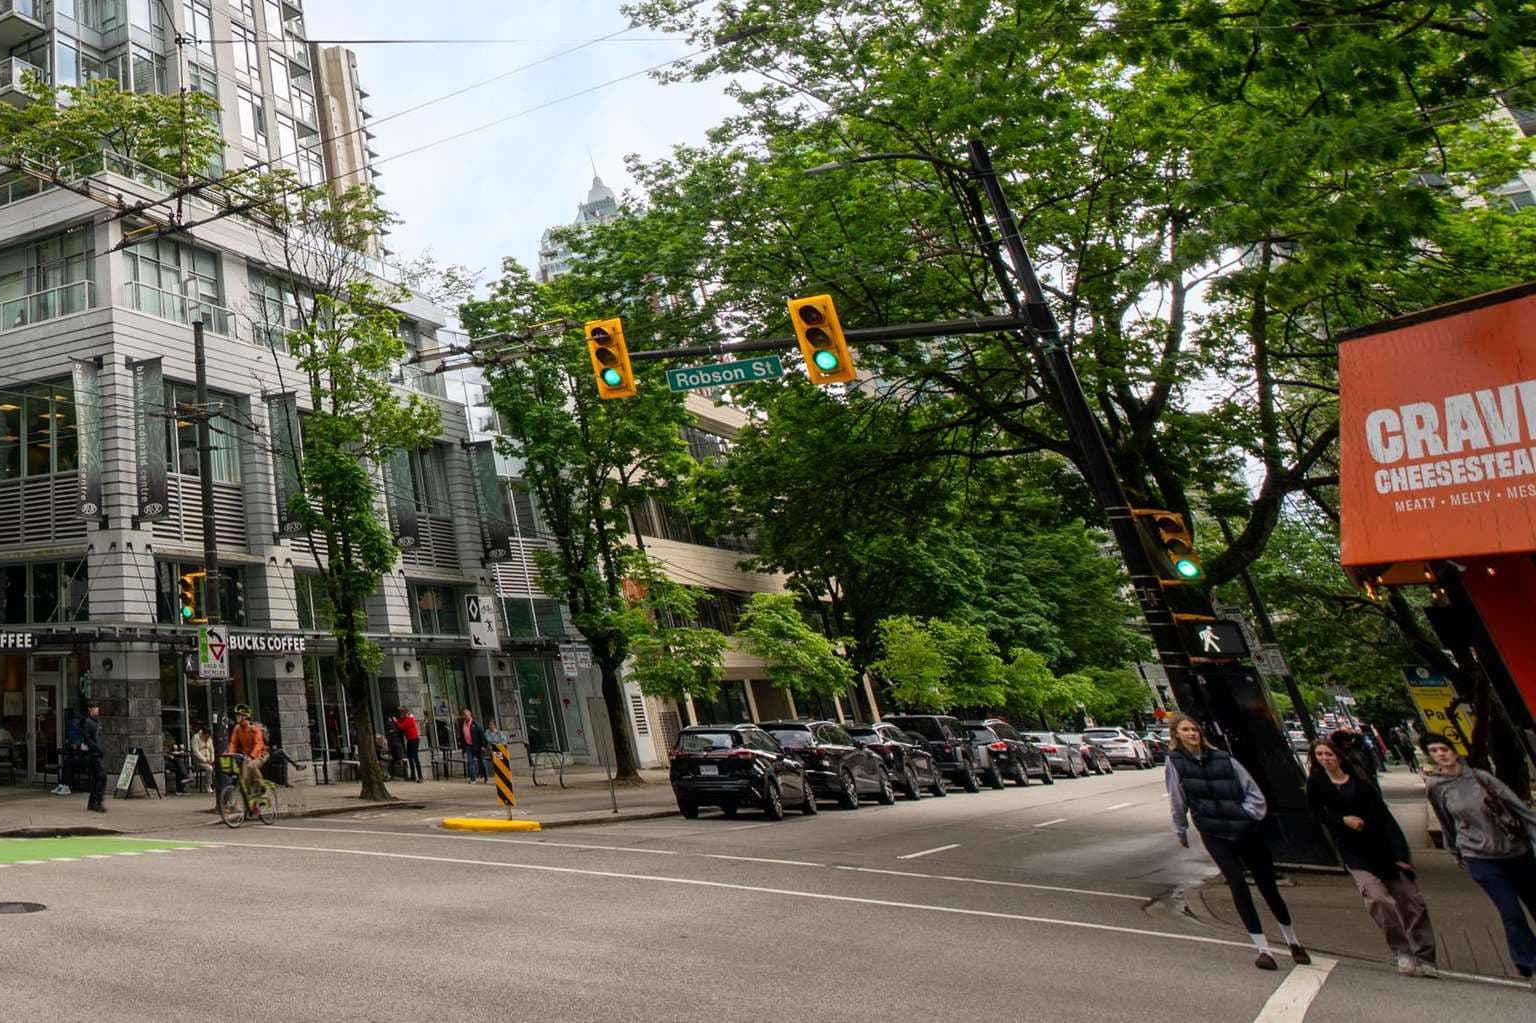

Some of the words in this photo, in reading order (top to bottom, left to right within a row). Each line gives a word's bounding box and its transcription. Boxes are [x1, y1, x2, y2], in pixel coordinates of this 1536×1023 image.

[675, 367, 745, 388] Robson
[751, 361, 775, 377] St
[80, 467, 89, 501] centre
[1374, 447, 1536, 495] CHEESESTEA
[1394, 496, 1436, 513] MEATY
[1450, 490, 1492, 506] MELTY
[266, 637, 306, 651] COFFEE
